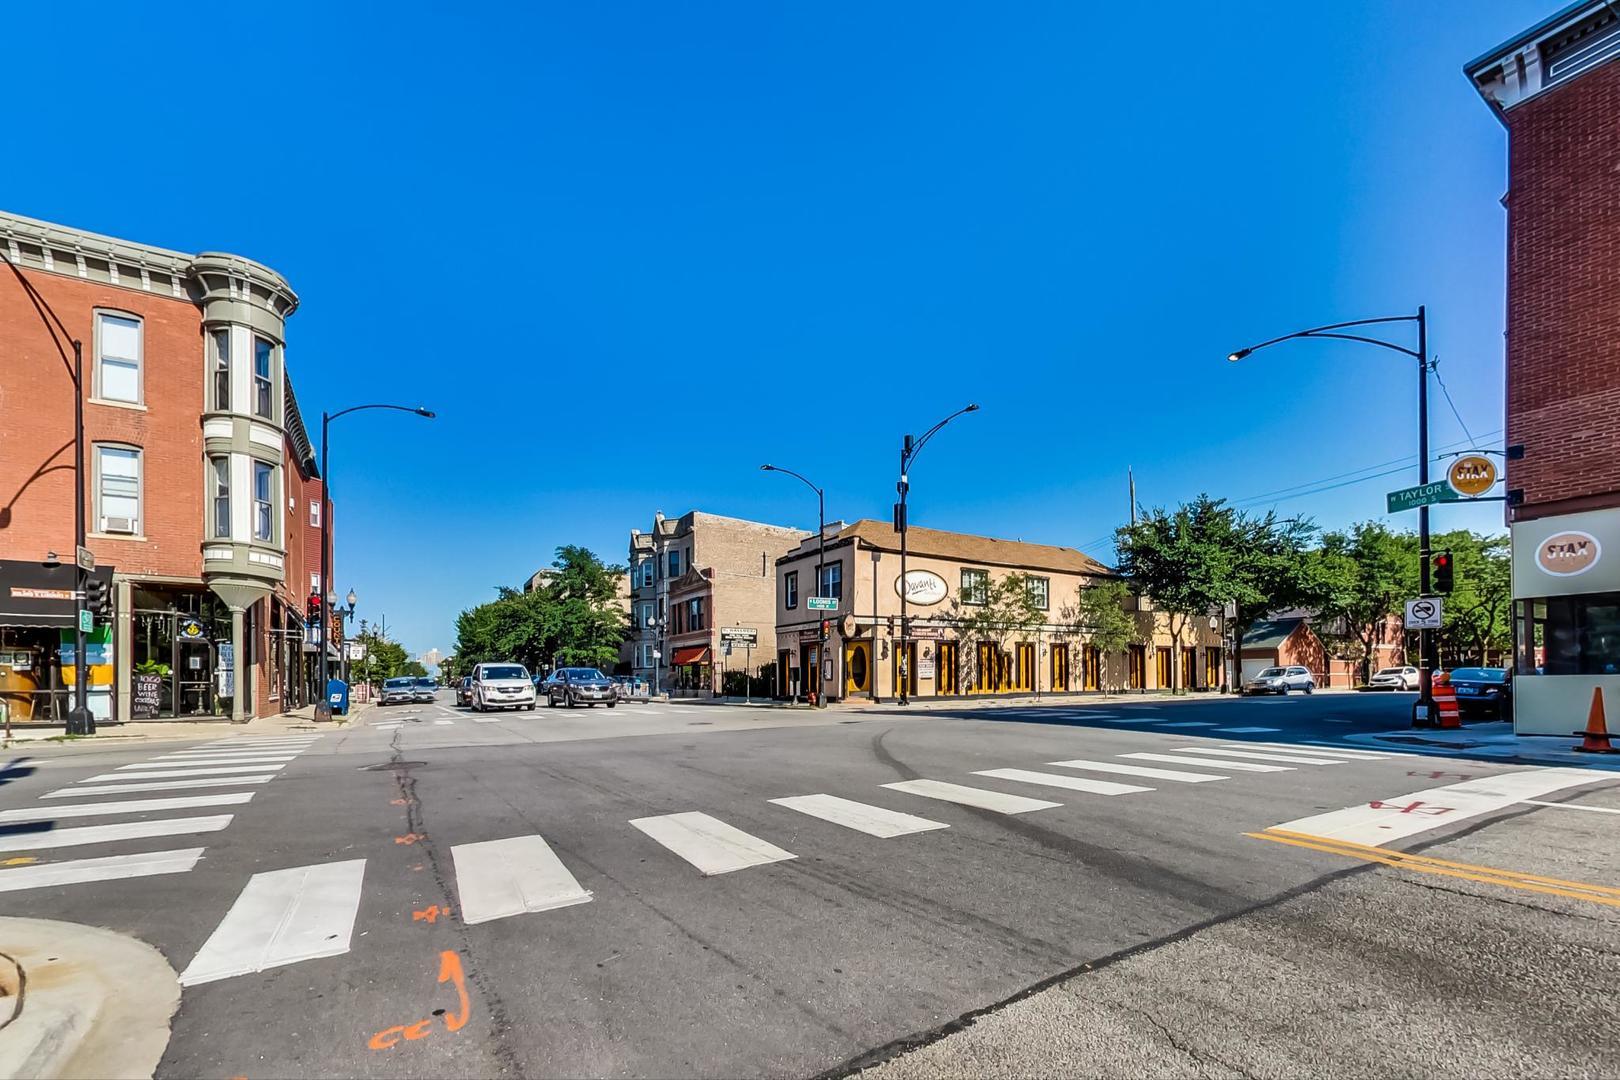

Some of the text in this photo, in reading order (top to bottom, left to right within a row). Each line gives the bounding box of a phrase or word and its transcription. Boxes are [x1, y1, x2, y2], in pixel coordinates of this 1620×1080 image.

[1456, 463, 1489, 480] STAX
[1399, 484, 1443, 502] TAYLOR
[1408, 497, 1427, 506] 1000
[1546, 541, 1588, 559] STAX
[137, 682, 157, 691] BEER
